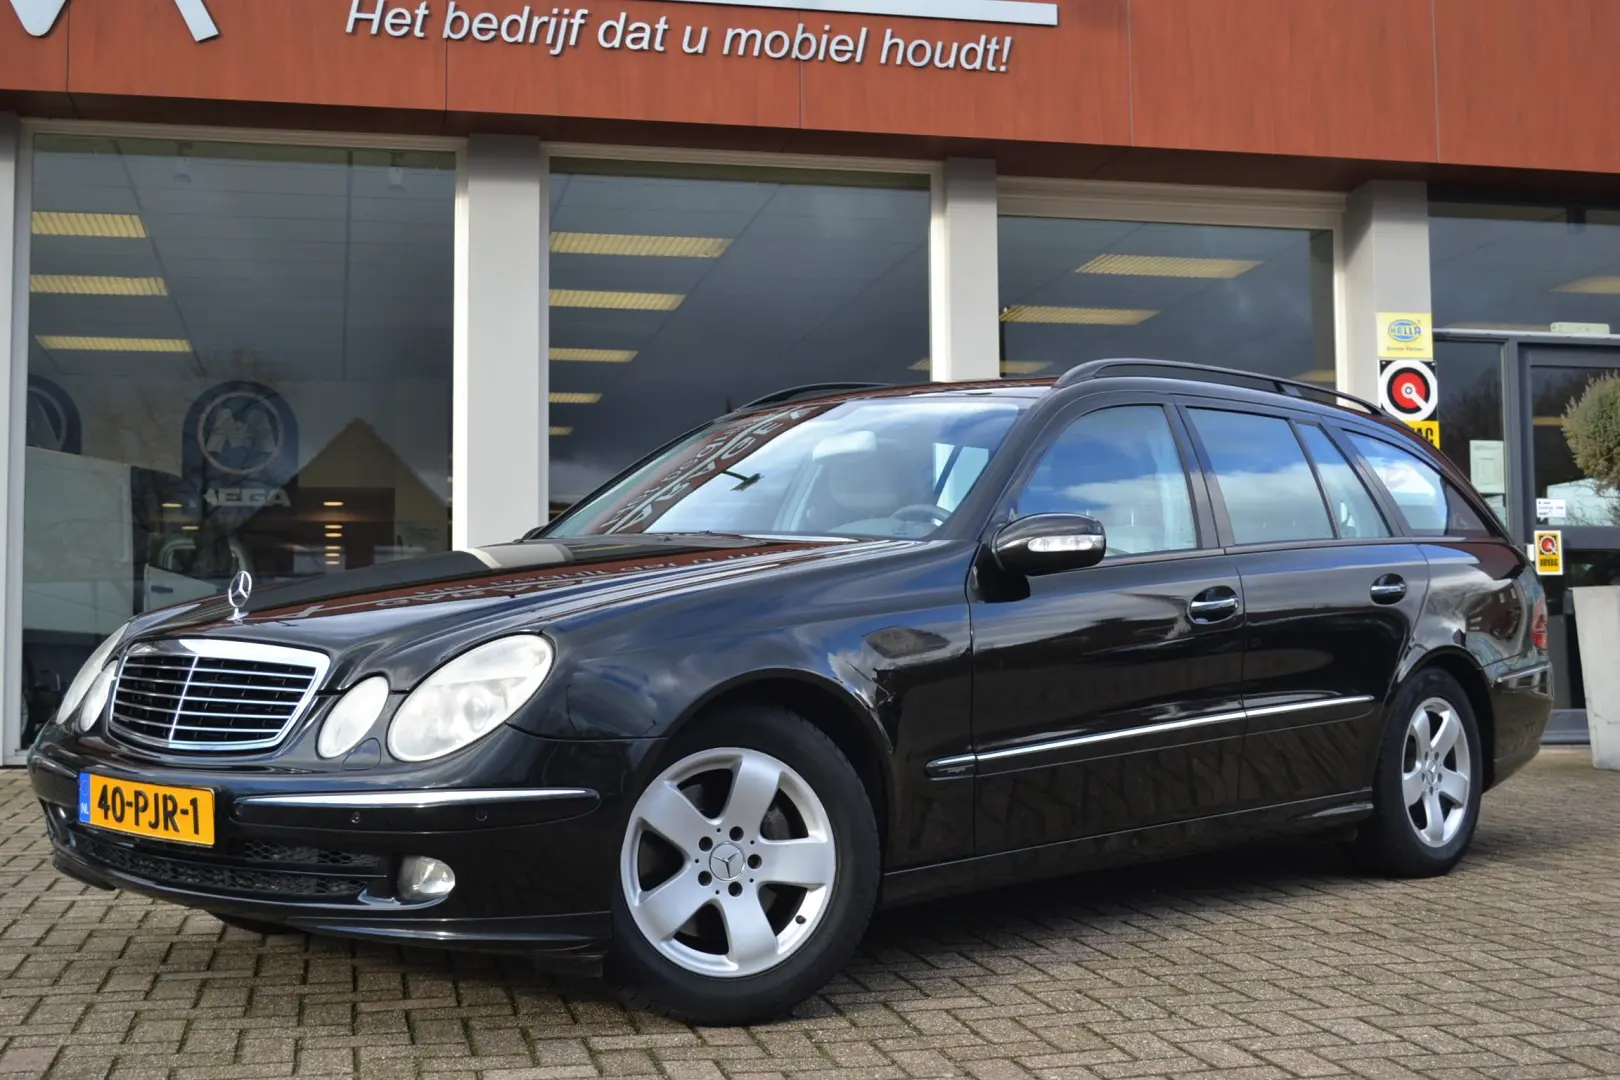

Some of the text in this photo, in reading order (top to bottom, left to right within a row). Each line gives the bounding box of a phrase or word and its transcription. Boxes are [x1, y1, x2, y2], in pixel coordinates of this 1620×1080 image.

[345, 0, 1012, 72] Het bedrijf dat u mobiel houdt!
[80, 784, 200, 835] NL 40-PJR-1
